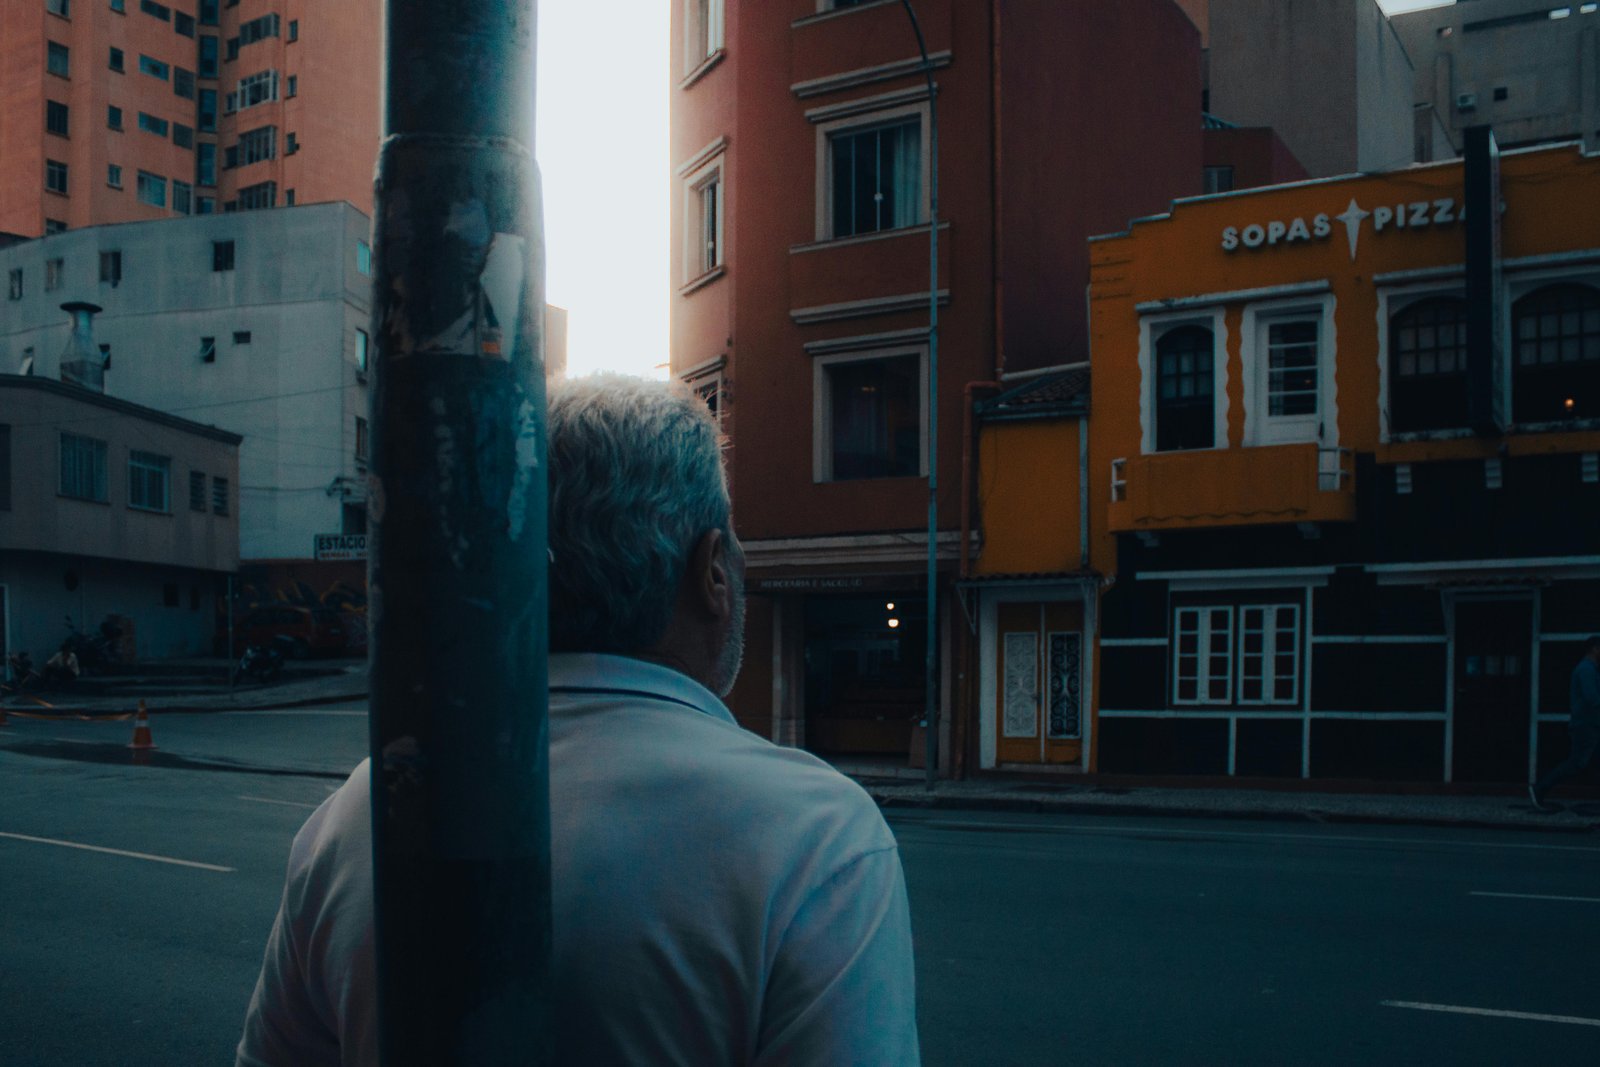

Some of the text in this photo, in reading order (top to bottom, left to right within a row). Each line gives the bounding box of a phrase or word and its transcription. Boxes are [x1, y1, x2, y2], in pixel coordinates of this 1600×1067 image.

[1221, 197, 1506, 251] SOPAS PIZZ
[319, 536, 368, 550] ESTACIO
